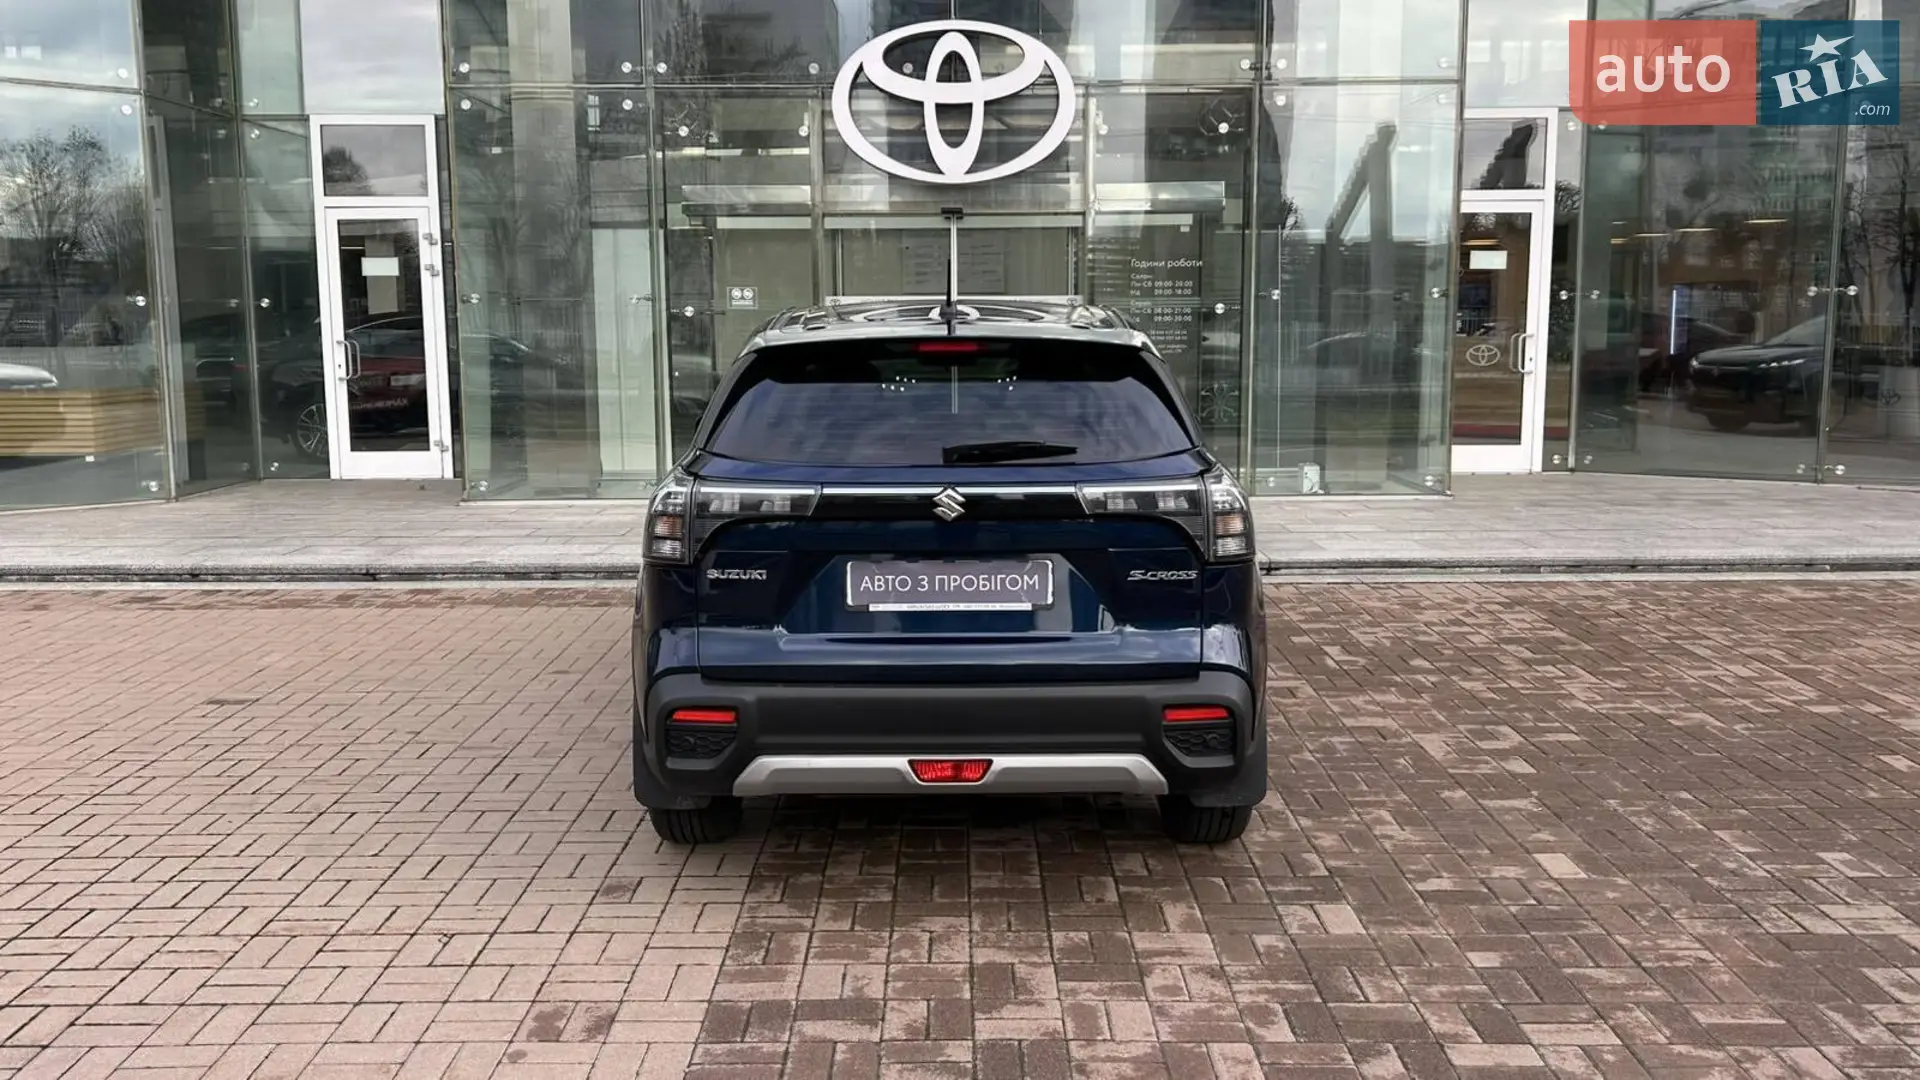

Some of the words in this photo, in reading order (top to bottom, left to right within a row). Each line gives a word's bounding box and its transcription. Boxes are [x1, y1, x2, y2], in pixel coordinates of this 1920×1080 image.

[1130, 258, 1165, 269] Години
[1167, 258, 1203, 269] роботи
[706, 569, 767, 580] SUZUKI
[860, 575, 912, 591] АВТО
[935, 574, 1040, 591] ПРОБІГОМ
